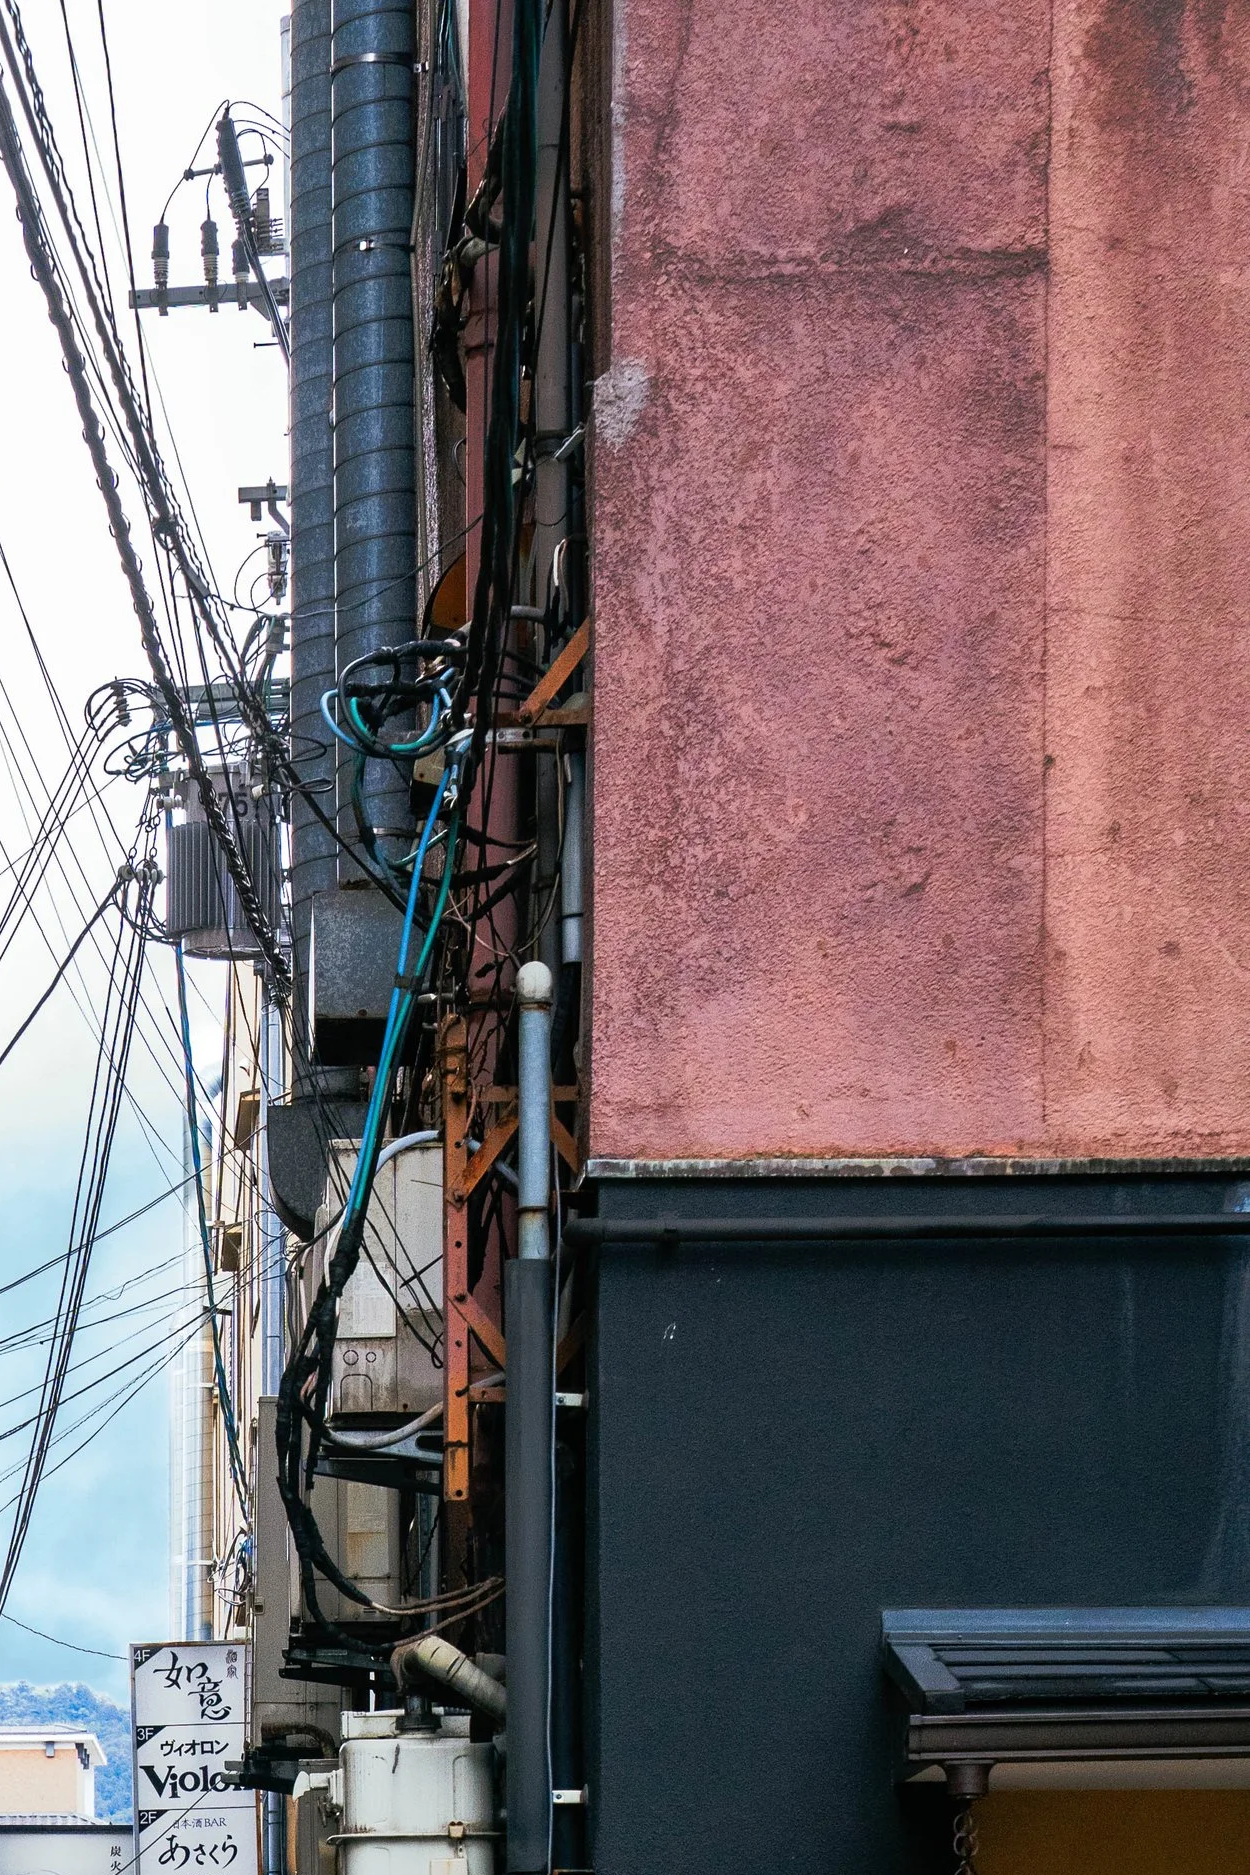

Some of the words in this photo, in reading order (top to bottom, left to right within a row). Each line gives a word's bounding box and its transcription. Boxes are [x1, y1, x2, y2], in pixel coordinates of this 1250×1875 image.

[134, 1650, 150, 1662] 4F
[153, 1651, 231, 1721] 如意
[137, 1728, 154, 1741] 3F
[160, 1740, 229, 1757] ヴィオロン
[139, 1765, 254, 1799] Violo
[140, 1812, 157, 1825] 2F
[158, 1834, 238, 1870] あさくら
